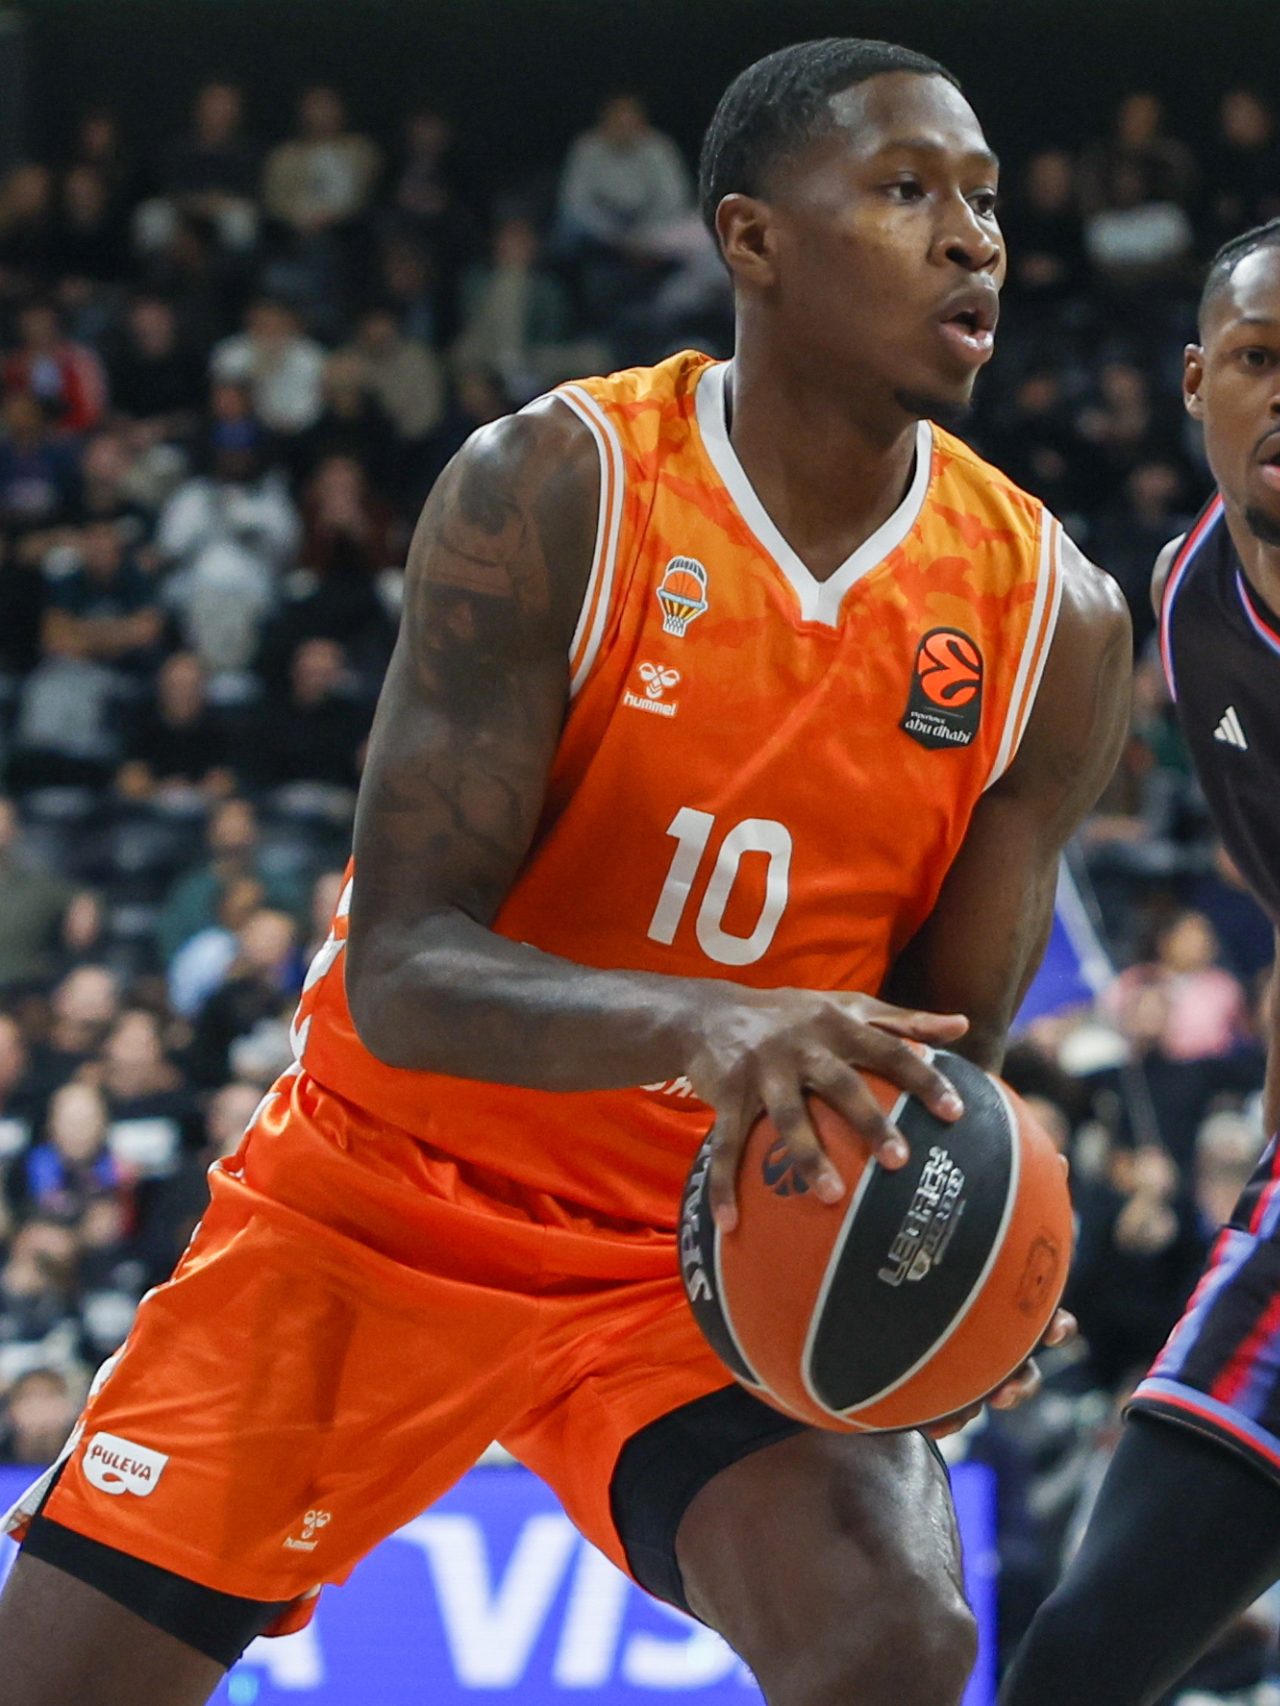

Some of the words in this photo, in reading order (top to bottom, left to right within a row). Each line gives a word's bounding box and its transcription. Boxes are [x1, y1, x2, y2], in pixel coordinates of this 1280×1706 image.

[623, 691, 677, 716] hummel
[905, 719, 932, 734] abu
[932, 725, 972, 744] dhabi
[647, 806, 793, 966] 10
[682, 1140, 713, 1302] SPAL
[90, 1444, 152, 1481] PULEVA
[395, 1512, 757, 1690] VIS
